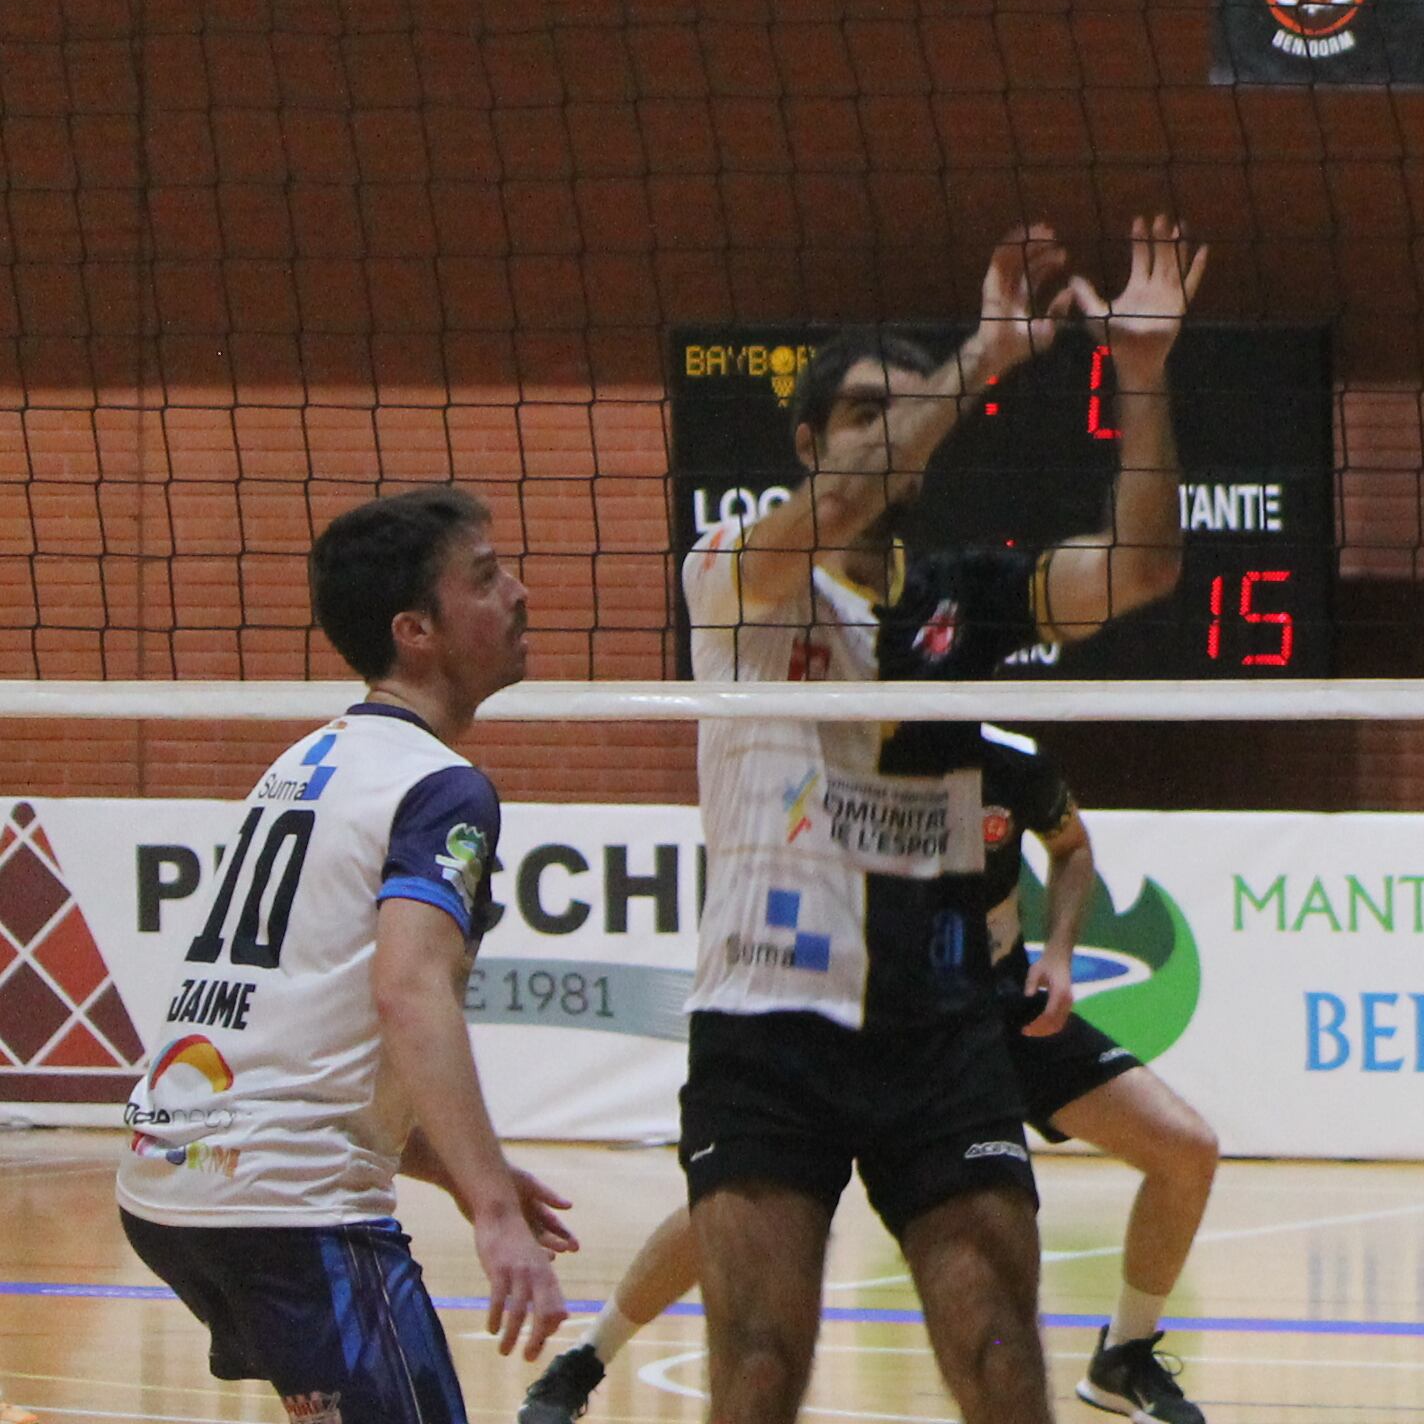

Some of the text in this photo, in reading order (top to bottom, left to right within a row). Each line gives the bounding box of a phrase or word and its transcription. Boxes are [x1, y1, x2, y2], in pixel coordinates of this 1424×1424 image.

[1206, 571, 1293, 666] 15
[258, 773, 308, 802] Suma
[186, 805, 316, 969] 10
[167, 978, 256, 1031] JAIME
[504, 970, 614, 1018] 1981
